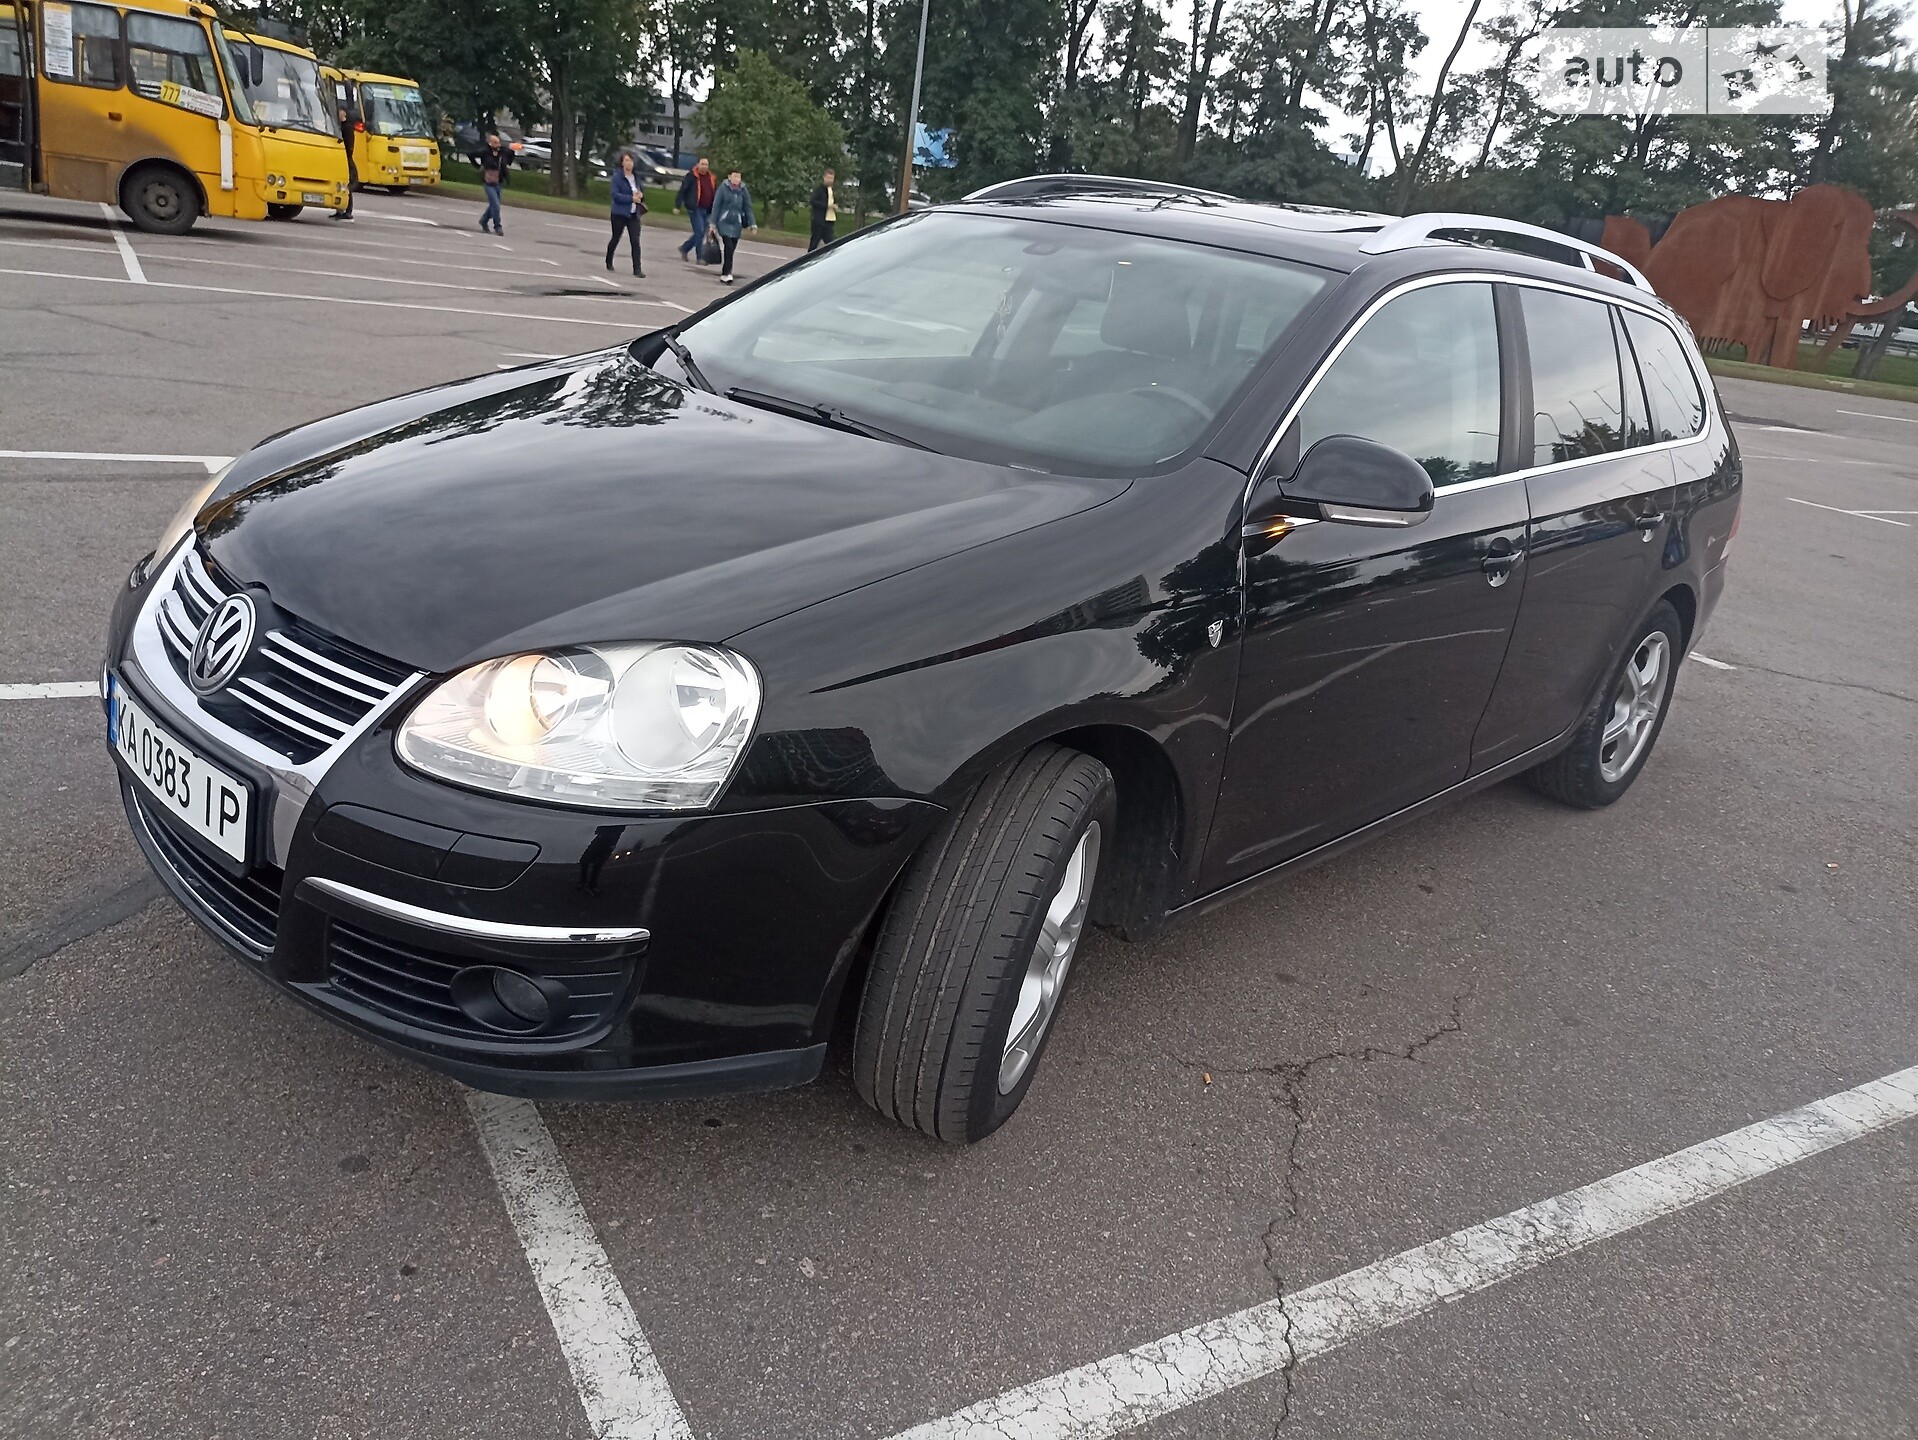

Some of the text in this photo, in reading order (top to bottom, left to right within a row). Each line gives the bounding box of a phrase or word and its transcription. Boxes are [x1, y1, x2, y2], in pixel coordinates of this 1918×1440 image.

[162, 84, 181, 103] 777
[118, 697, 241, 837] KA 0383 IP
